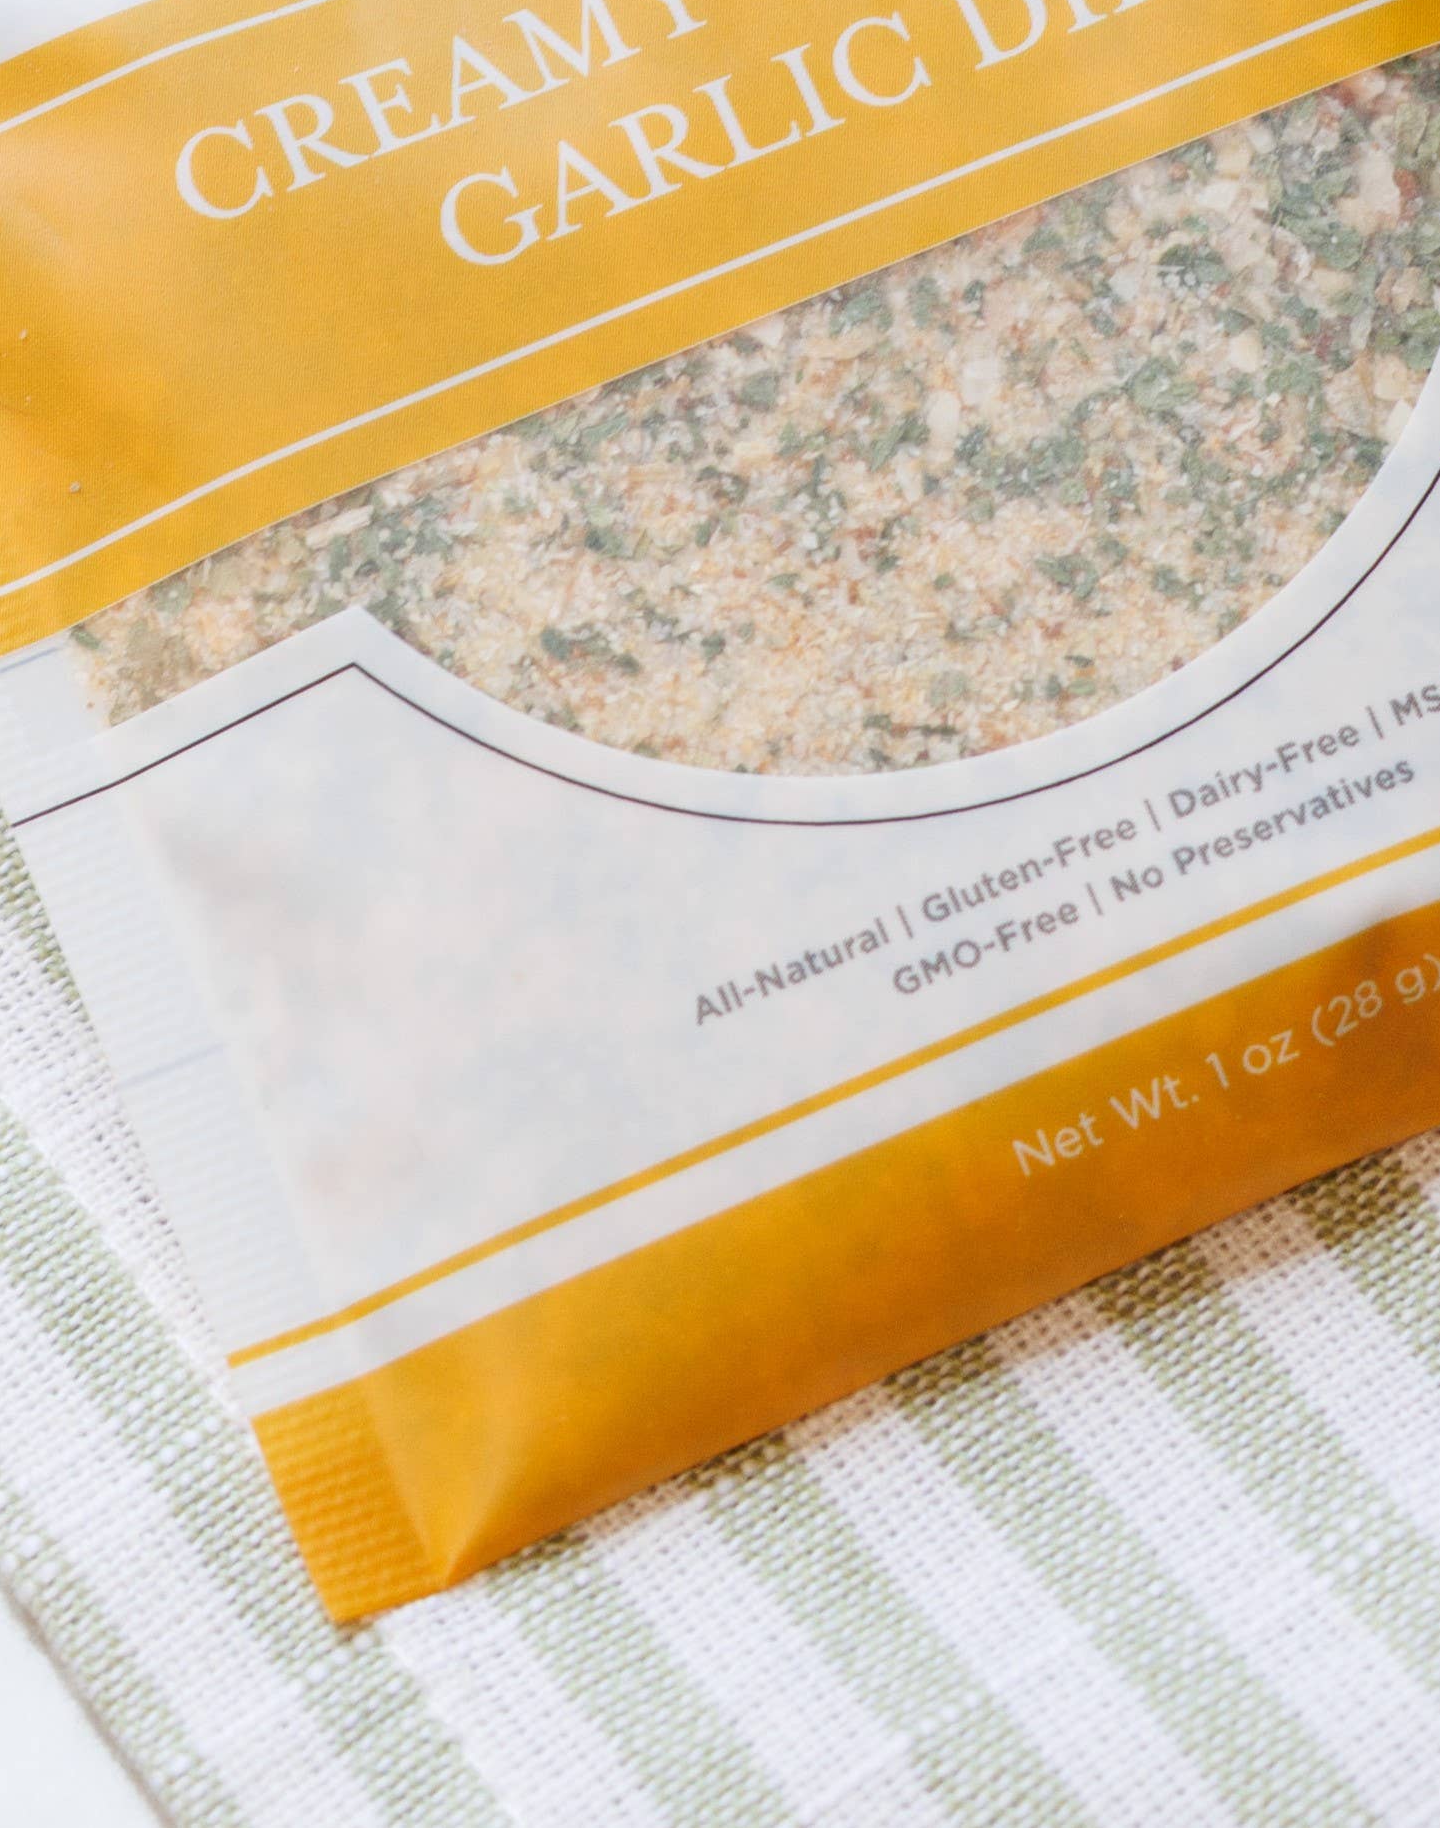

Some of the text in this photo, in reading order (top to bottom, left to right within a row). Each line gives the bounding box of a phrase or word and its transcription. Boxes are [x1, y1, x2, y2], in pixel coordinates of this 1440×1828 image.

[439, 13, 933, 267] GARLIC
[694, 906, 891, 1026] All-Natural
[921, 812, 1139, 925] Gluten-Free
[1168, 720, 1361, 821] Dairy-Free
[892, 758, 1416, 999] GMO-Free No Preservatives
[1012, 1106, 1106, 1178] Net
[1109, 1075, 1202, 1129] Wt.
[1204, 1053, 1226, 1090] 1
[1242, 1029, 1301, 1077] oz
[1310, 979, 1385, 1049] (28
